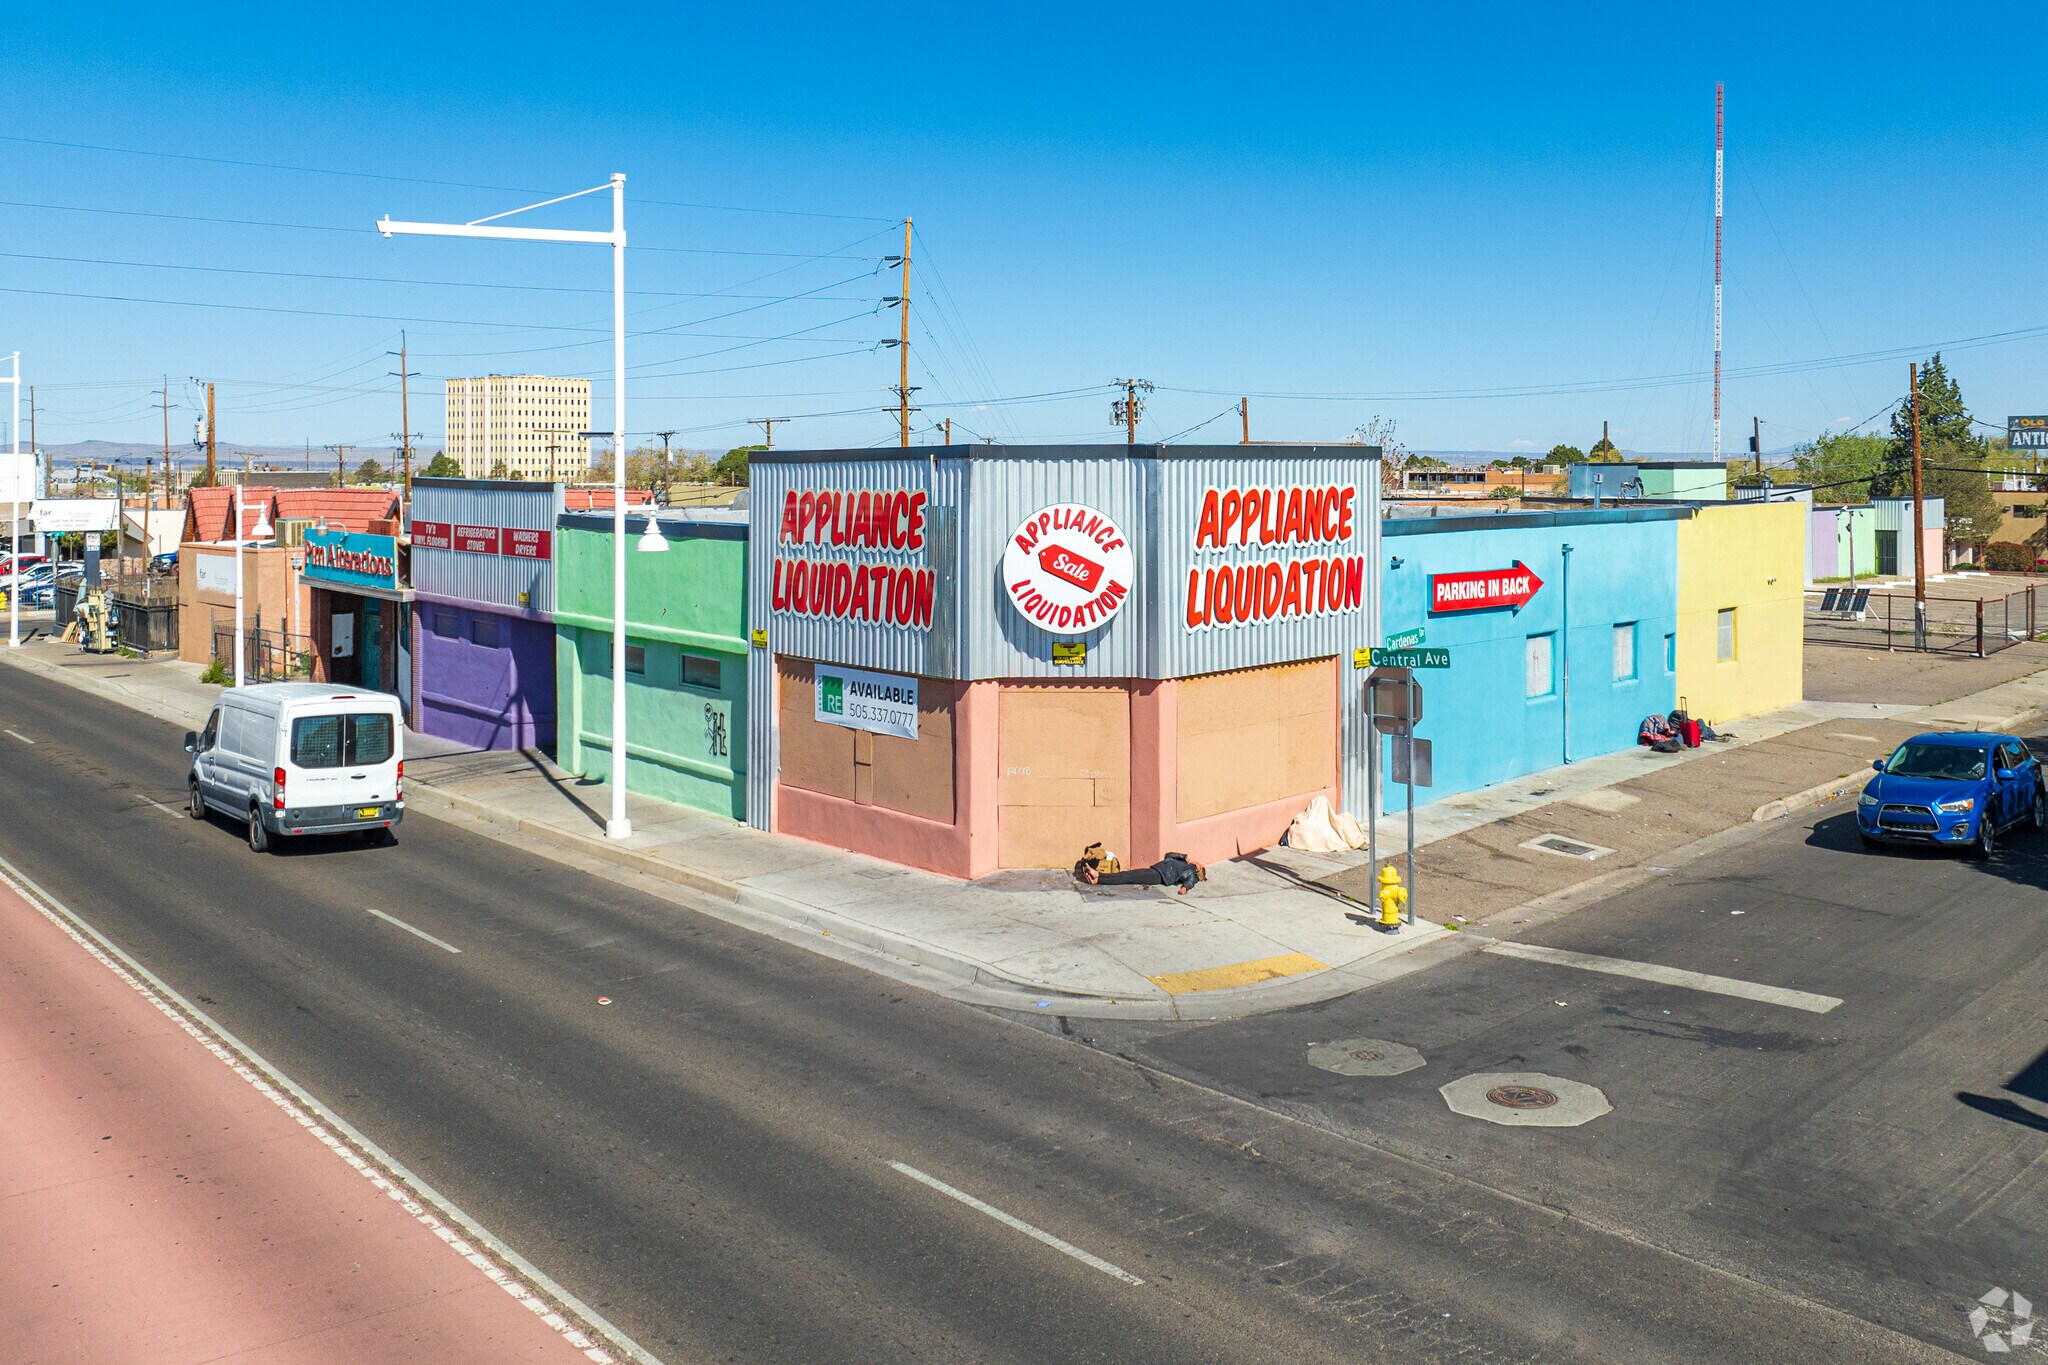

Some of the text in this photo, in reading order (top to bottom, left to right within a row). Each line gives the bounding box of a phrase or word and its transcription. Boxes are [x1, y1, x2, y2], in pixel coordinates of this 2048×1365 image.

[2012, 431, 2048, 446] ANTI
[779, 490, 927, 550] APPLIANCE
[1196, 486, 1355, 549] APPLIANCE
[426, 535, 449, 548] FLOORING
[456, 526, 496, 540] REFRIGERATORS
[513, 531, 539, 543] WASHERS
[1014, 508, 1125, 555] APPLIANCE
[466, 540, 486, 551] STOVES
[515, 544, 537, 556] DRYERS
[305, 540, 394, 577] Pim Alterations
[1053, 553, 1090, 581] Sale
[772, 558, 935, 628] LIQUIDATION
[1186, 556, 1364, 628] LIQUIDATION
[1437, 576, 1530, 602] PARKING IN BACK
[1011, 579, 1128, 628] LIQUIDATION
[1386, 628, 1425, 651] Cardenas Dr
[1371, 649, 1421, 667] Central
[1424, 652, 1448, 665] Ave
[827, 694, 842, 713] RE
[850, 680, 914, 705] AVAILABLE
[849, 703, 914, 728] 505.337.0777
